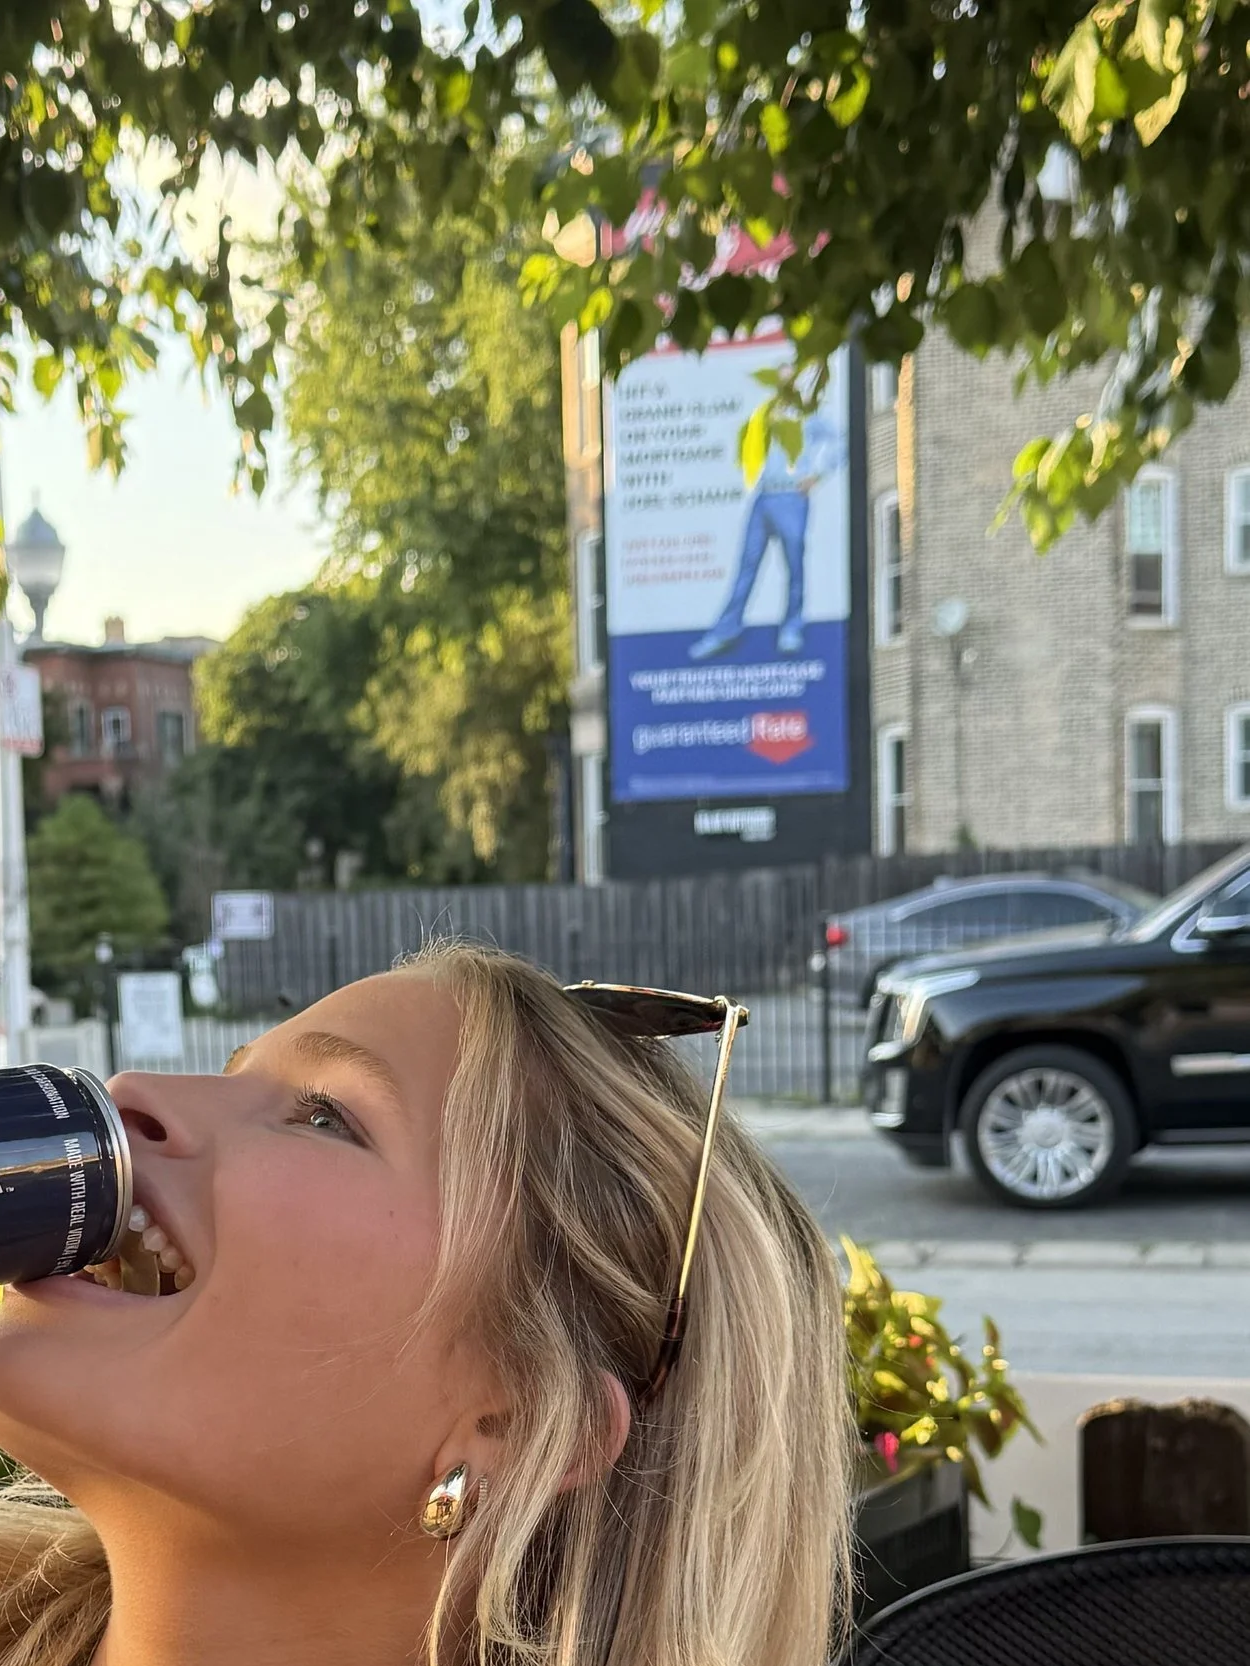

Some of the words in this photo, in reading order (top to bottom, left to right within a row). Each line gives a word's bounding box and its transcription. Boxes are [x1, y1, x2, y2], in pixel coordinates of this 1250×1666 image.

[634, 717, 751, 753] guaranteed
[754, 713, 806, 741] Rate
[63, 1138, 84, 1169] MADE
[69, 1169, 86, 1200] WITH
[69, 1201, 86, 1227] REAL
[62, 1227, 83, 1256] VODKA
